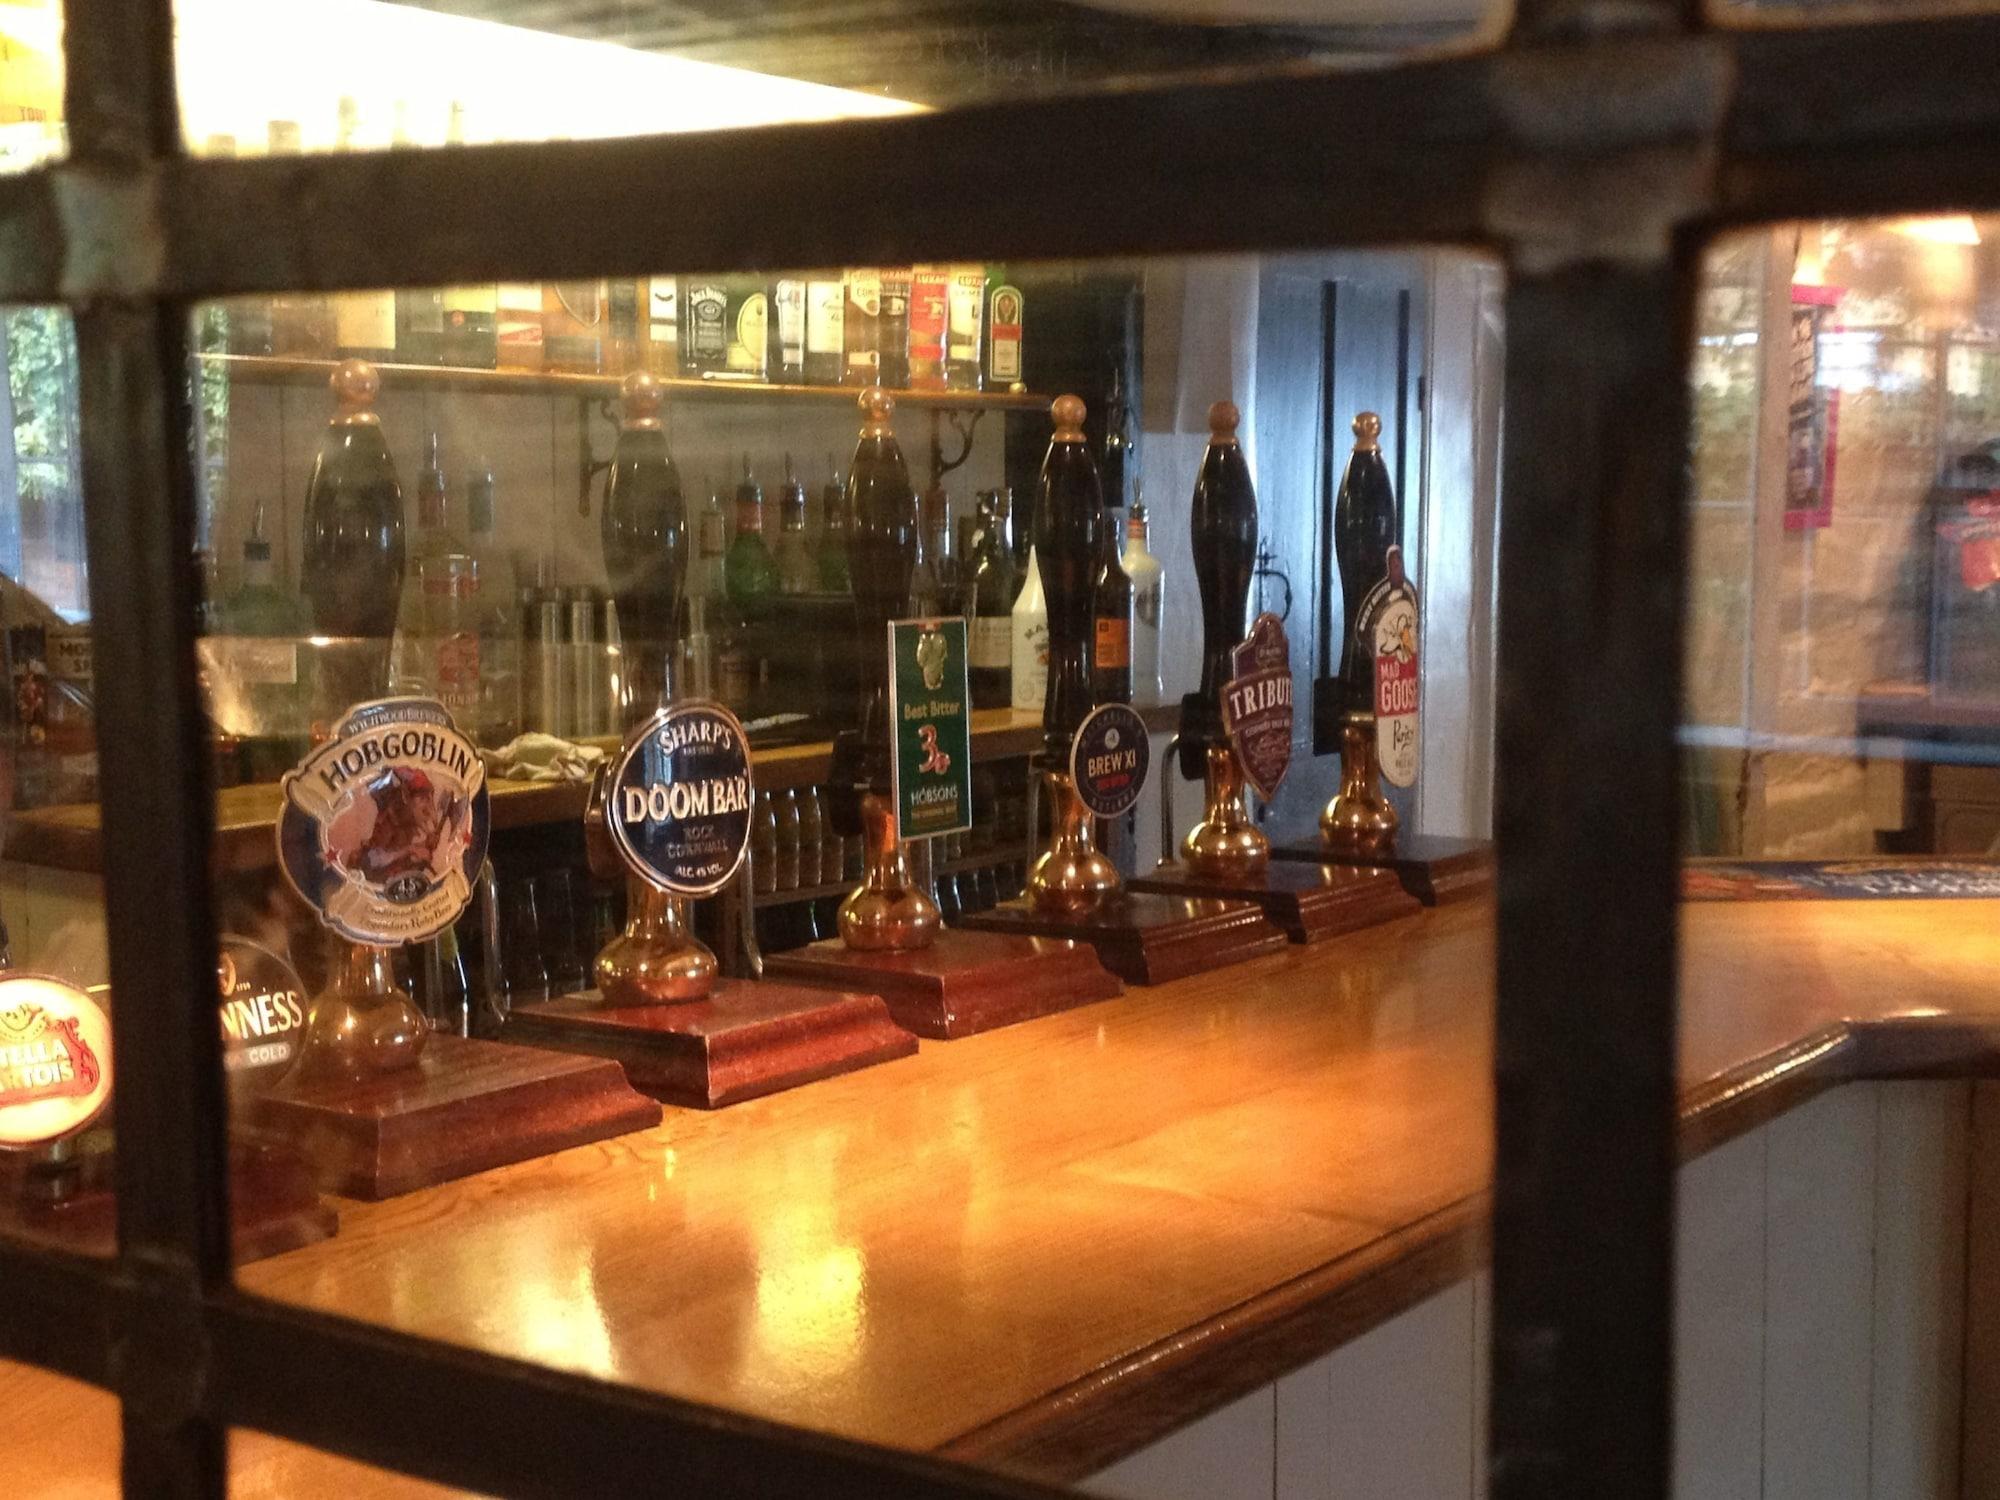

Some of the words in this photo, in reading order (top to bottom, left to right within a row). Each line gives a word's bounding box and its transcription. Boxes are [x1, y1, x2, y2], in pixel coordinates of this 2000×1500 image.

[1381, 661, 1400, 680] MAD
[904, 702, 928, 720] Best
[930, 700, 961, 717] Bitter
[659, 720, 732, 754] SHARP'S
[320, 731, 471, 793] HOBGOBLIN
[1088, 752, 1122, 778] BREW
[1124, 748, 1137, 770] XI
[624, 780, 710, 823] DOOM
[711, 775, 748, 815] BAR
[910, 784, 959, 807] HOBSONS
[221, 990, 303, 1040] NNESS
[249, 1044, 288, 1063] COLD
